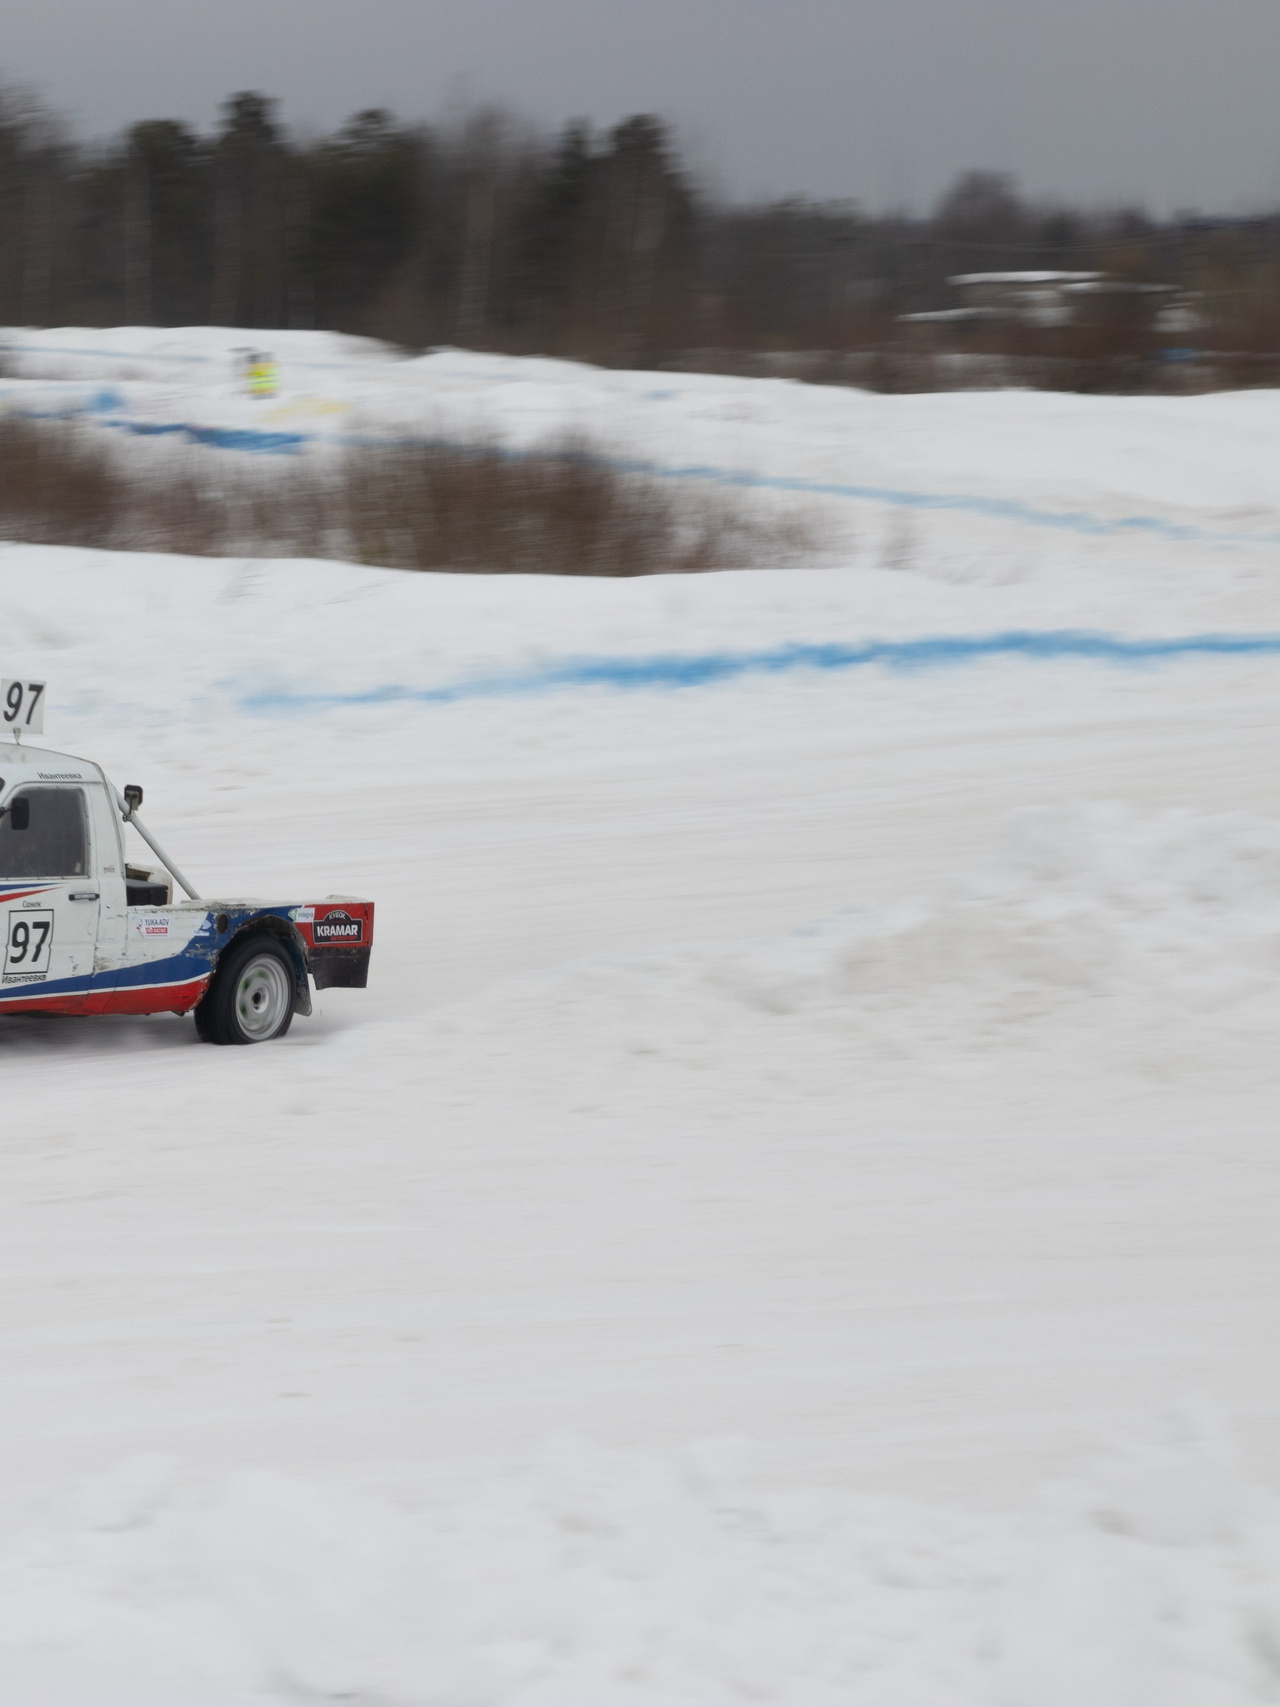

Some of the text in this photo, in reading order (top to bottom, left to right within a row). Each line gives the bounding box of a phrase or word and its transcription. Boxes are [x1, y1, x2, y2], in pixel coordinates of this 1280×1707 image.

[3, 681, 44, 725] 97
[37, 772, 83, 780] Ивантеевка
[317, 924, 358, 937] KRAMAR
[10, 921, 50, 964] 97
[2, 974, 47, 984] Ивантеевка
